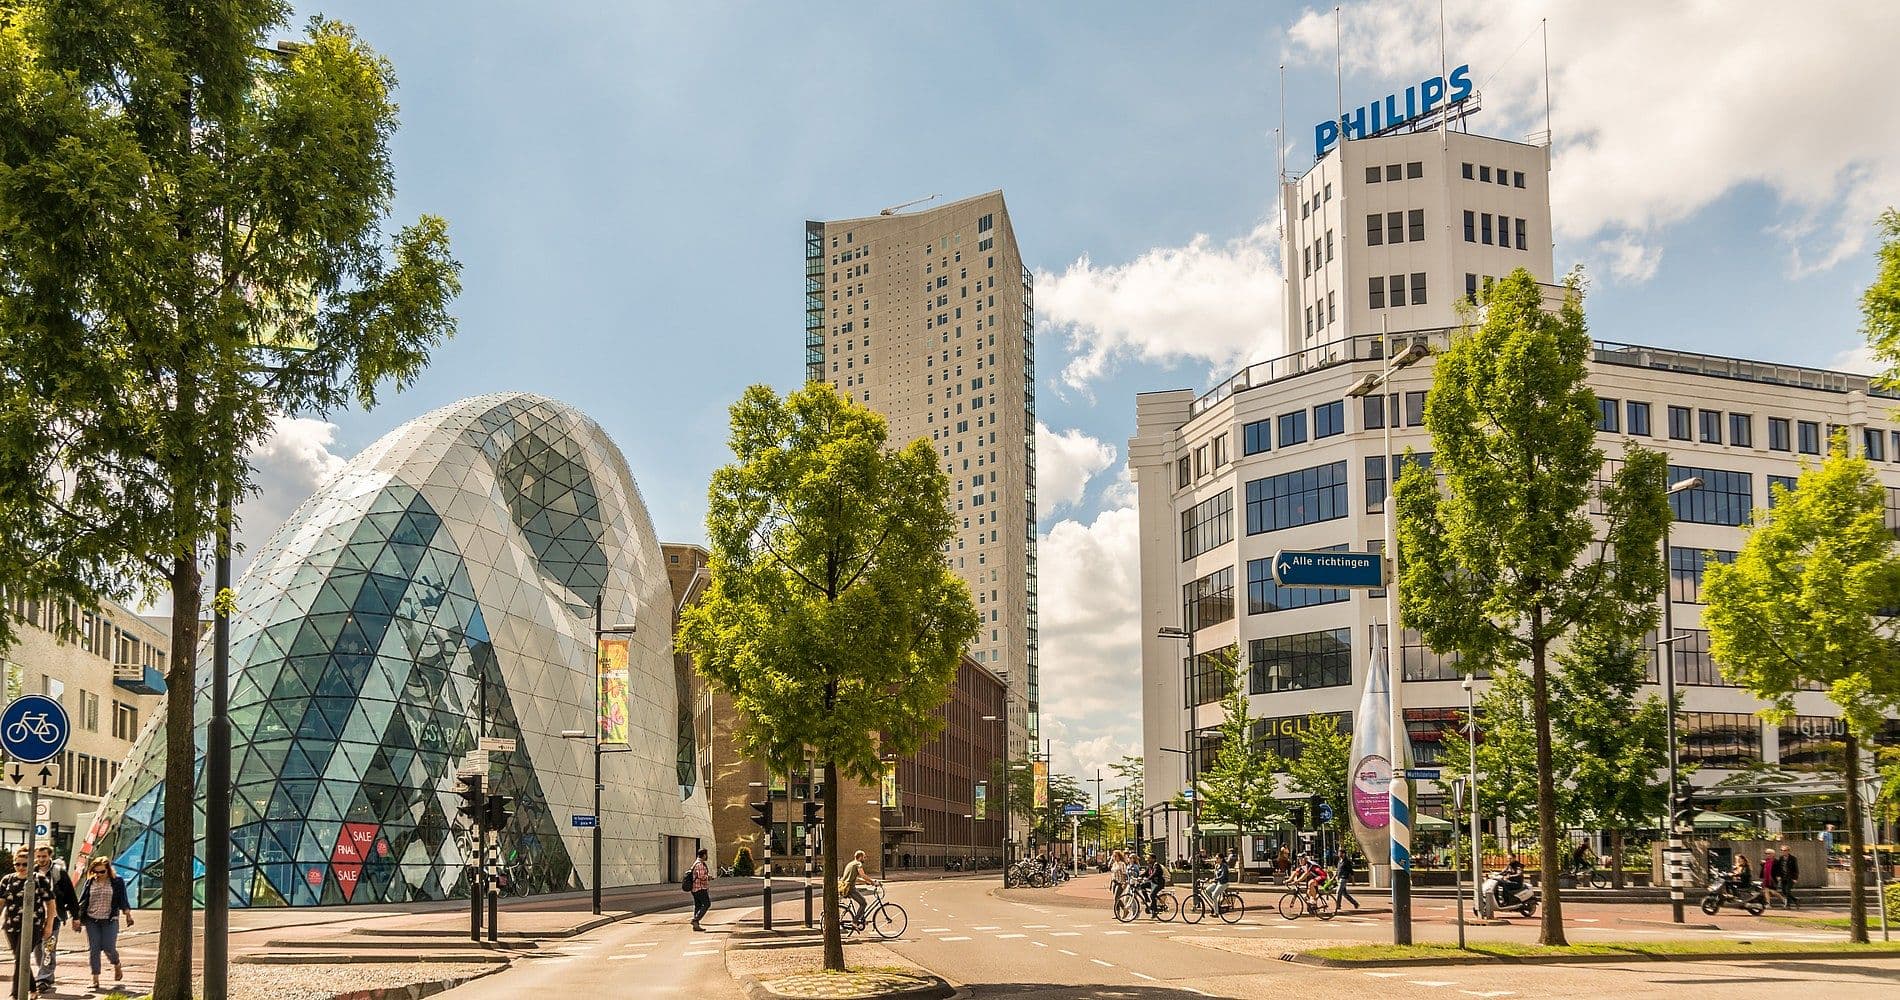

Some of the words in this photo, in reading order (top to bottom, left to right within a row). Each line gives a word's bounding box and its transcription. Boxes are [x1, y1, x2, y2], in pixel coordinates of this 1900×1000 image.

[1315, 64, 1473, 157] PHILIPS
[1292, 556, 1313, 566] Alle
[1317, 557, 1370, 569] richtingen
[353, 831, 372, 842] SALE
[337, 845, 355, 855] FINAL
[337, 870, 357, 881] SALE
